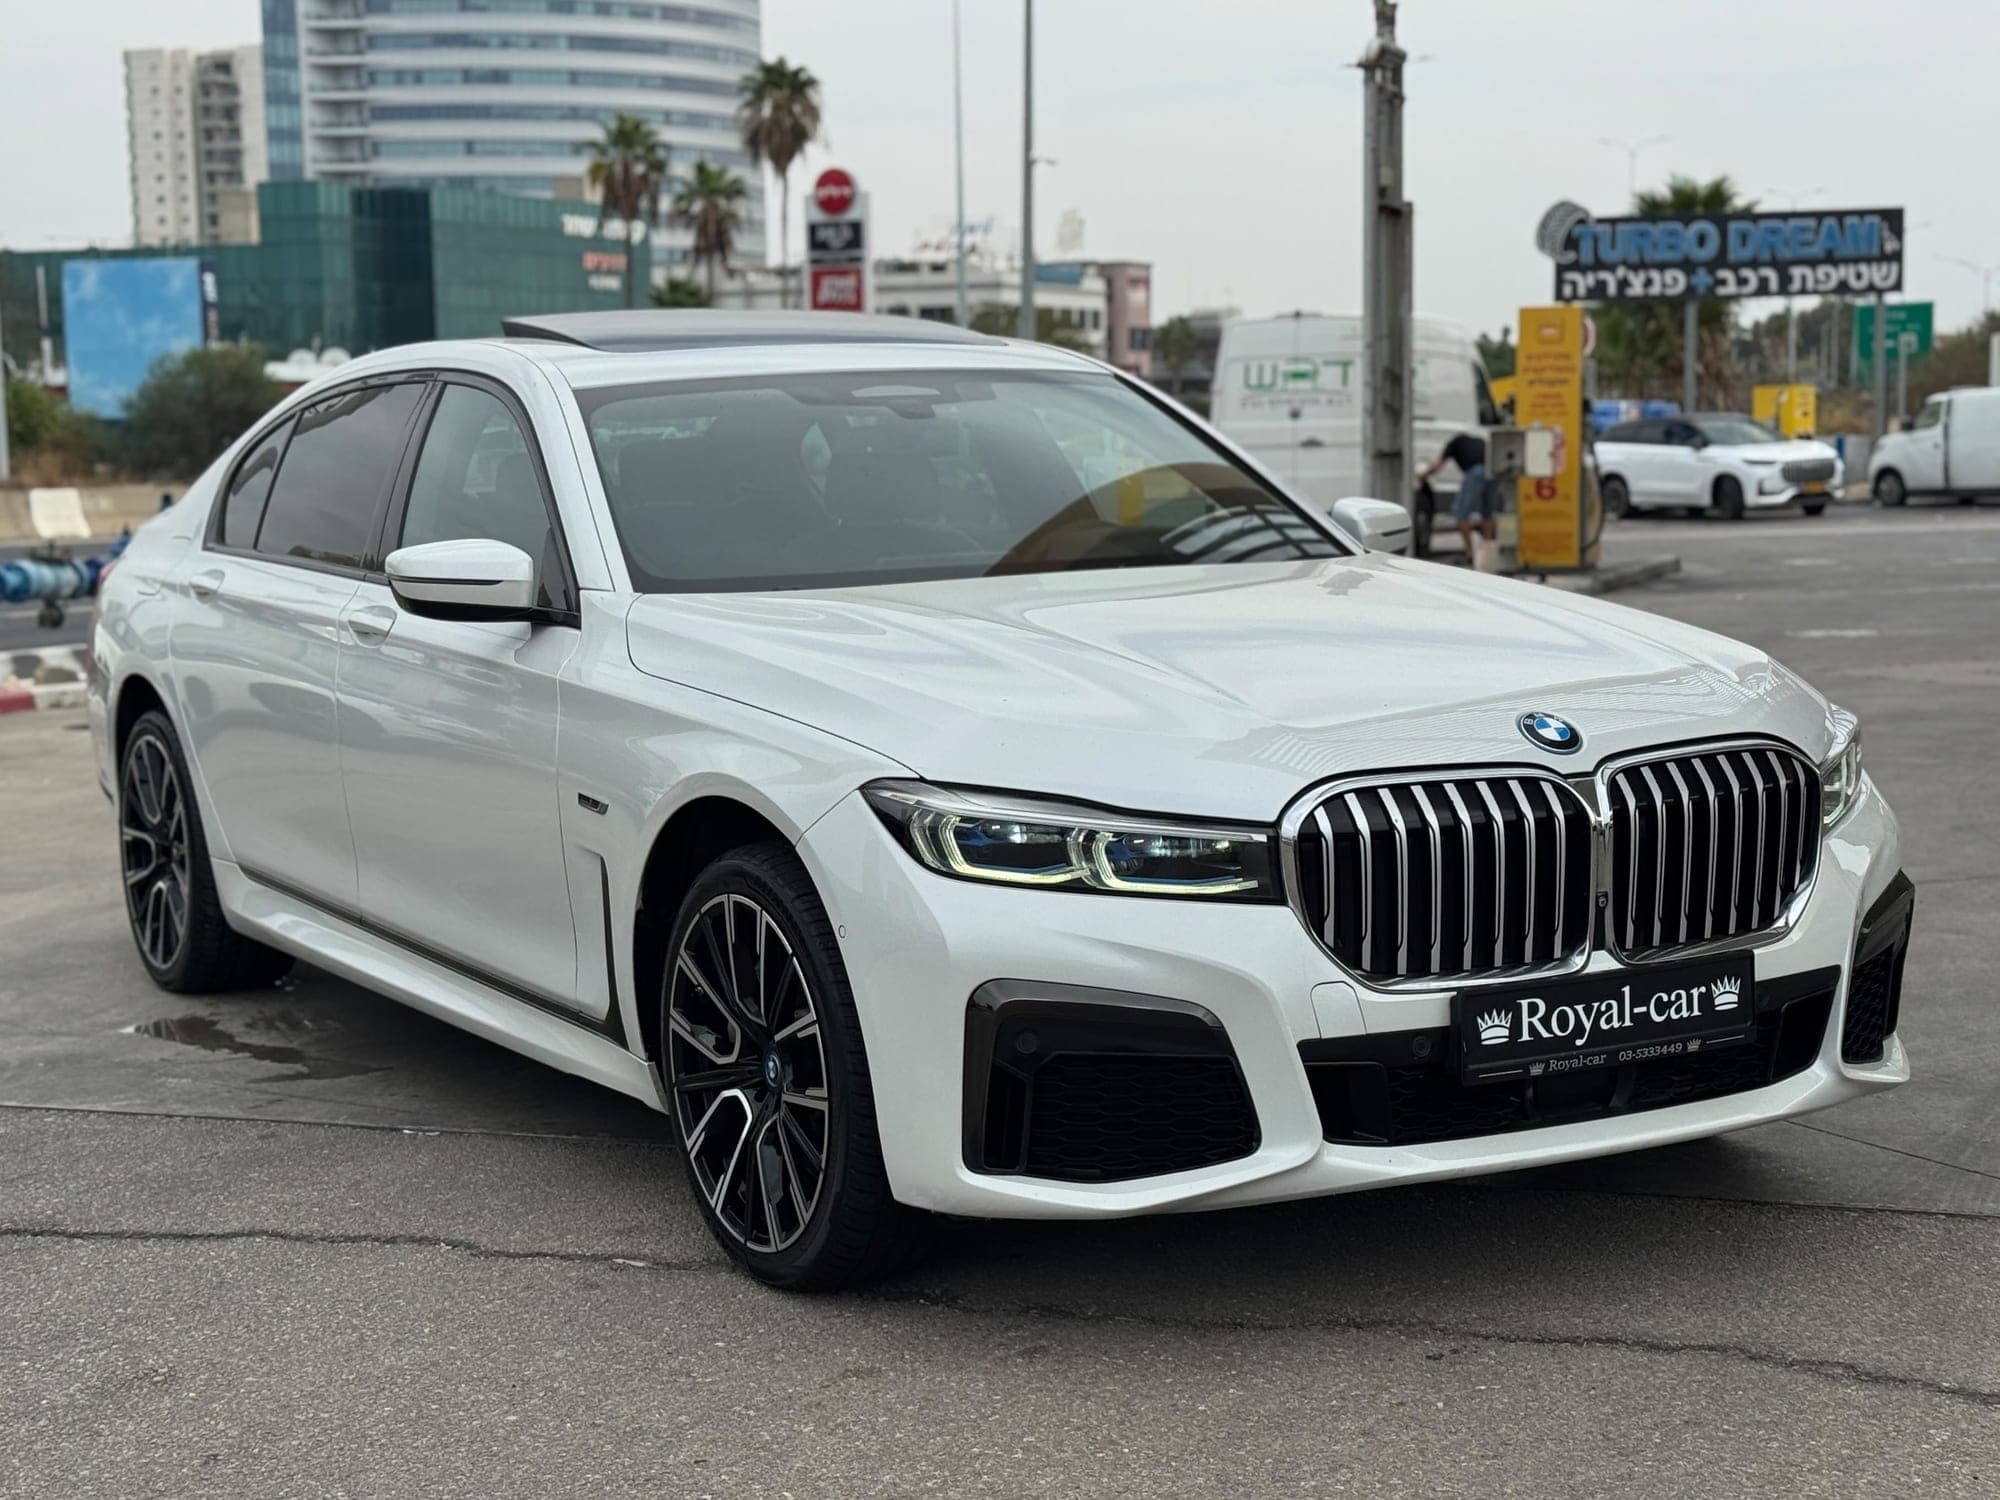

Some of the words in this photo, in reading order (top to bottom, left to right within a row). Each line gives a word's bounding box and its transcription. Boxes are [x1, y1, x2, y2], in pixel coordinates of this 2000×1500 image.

[1573, 219, 1720, 264] TURBO
[1727, 215, 1882, 263] DREAM
[1787, 261, 1900, 293] שטיפת
[1516, 985, 1706, 1046] Royal-car
[1548, 1052, 1607, 1072] Royal-car
[1618, 1042, 1683, 1062] 03-5333449
